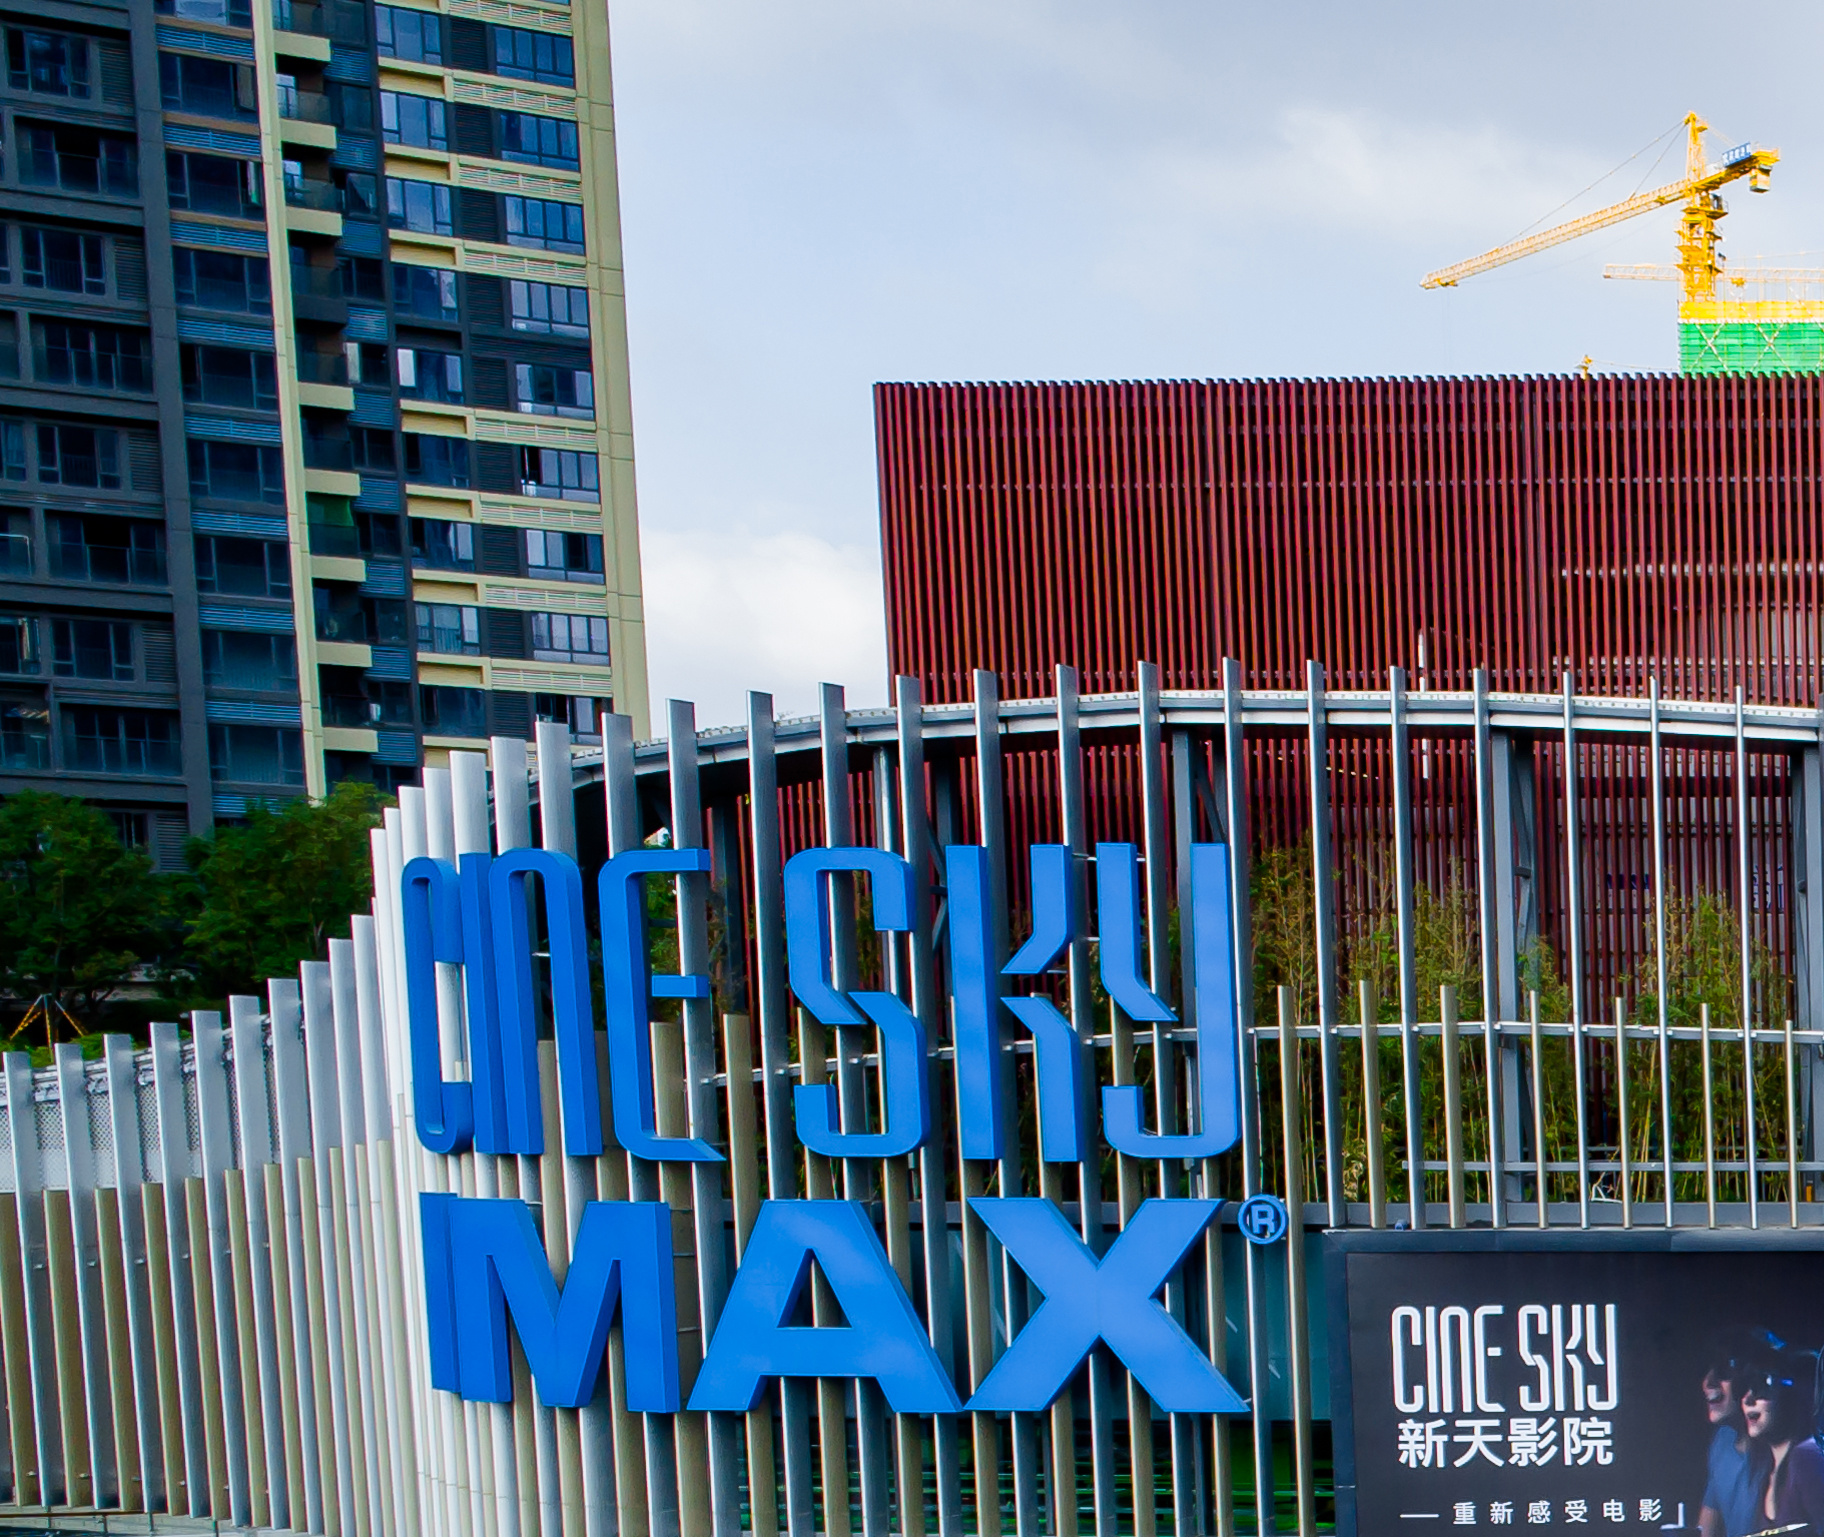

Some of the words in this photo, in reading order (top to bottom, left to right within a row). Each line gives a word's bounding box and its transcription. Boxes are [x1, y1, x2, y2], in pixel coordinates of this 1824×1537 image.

[401, 846, 726, 1162] CINE
[783, 842, 1239, 1163] SKY
[418, 1192, 1251, 1414] IMAX
[1391, 1305, 1506, 1413] CINE
[1518, 1304, 1618, 1412] SKY
[1397, 1417, 1614, 1468] 新天影院
